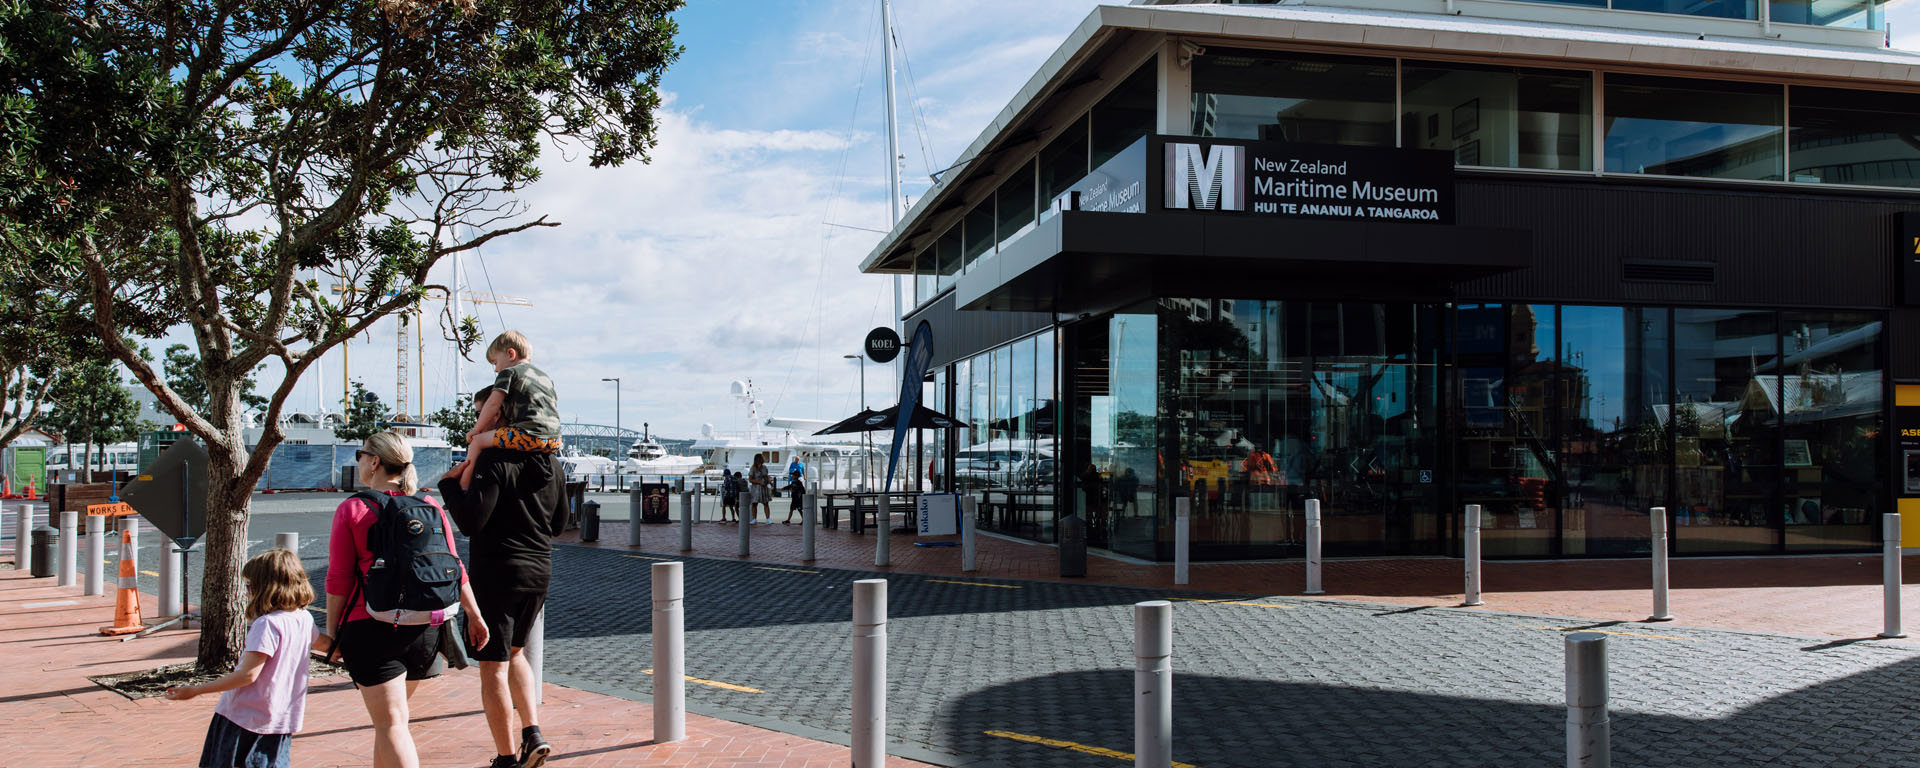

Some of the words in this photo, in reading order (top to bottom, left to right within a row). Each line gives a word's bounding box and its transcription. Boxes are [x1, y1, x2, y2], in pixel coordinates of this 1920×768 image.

[1255, 157, 1287, 172] New
[1290, 159, 1347, 175] Zealand
[1109, 181, 1140, 211] Museum
[1254, 176, 1347, 199] Maritime
[1352, 181, 1438, 203] Museum
[1254, 202, 1277, 214] HUI
[1280, 203, 1297, 214] TE
[1300, 204, 1351, 217] ANANUI
[1354, 206, 1365, 217] A
[1367, 207, 1439, 220] TANGAROA
[871, 339, 895, 349] KOEL
[89, 505, 117, 515] WORKS
[121, 504, 132, 512] EN
